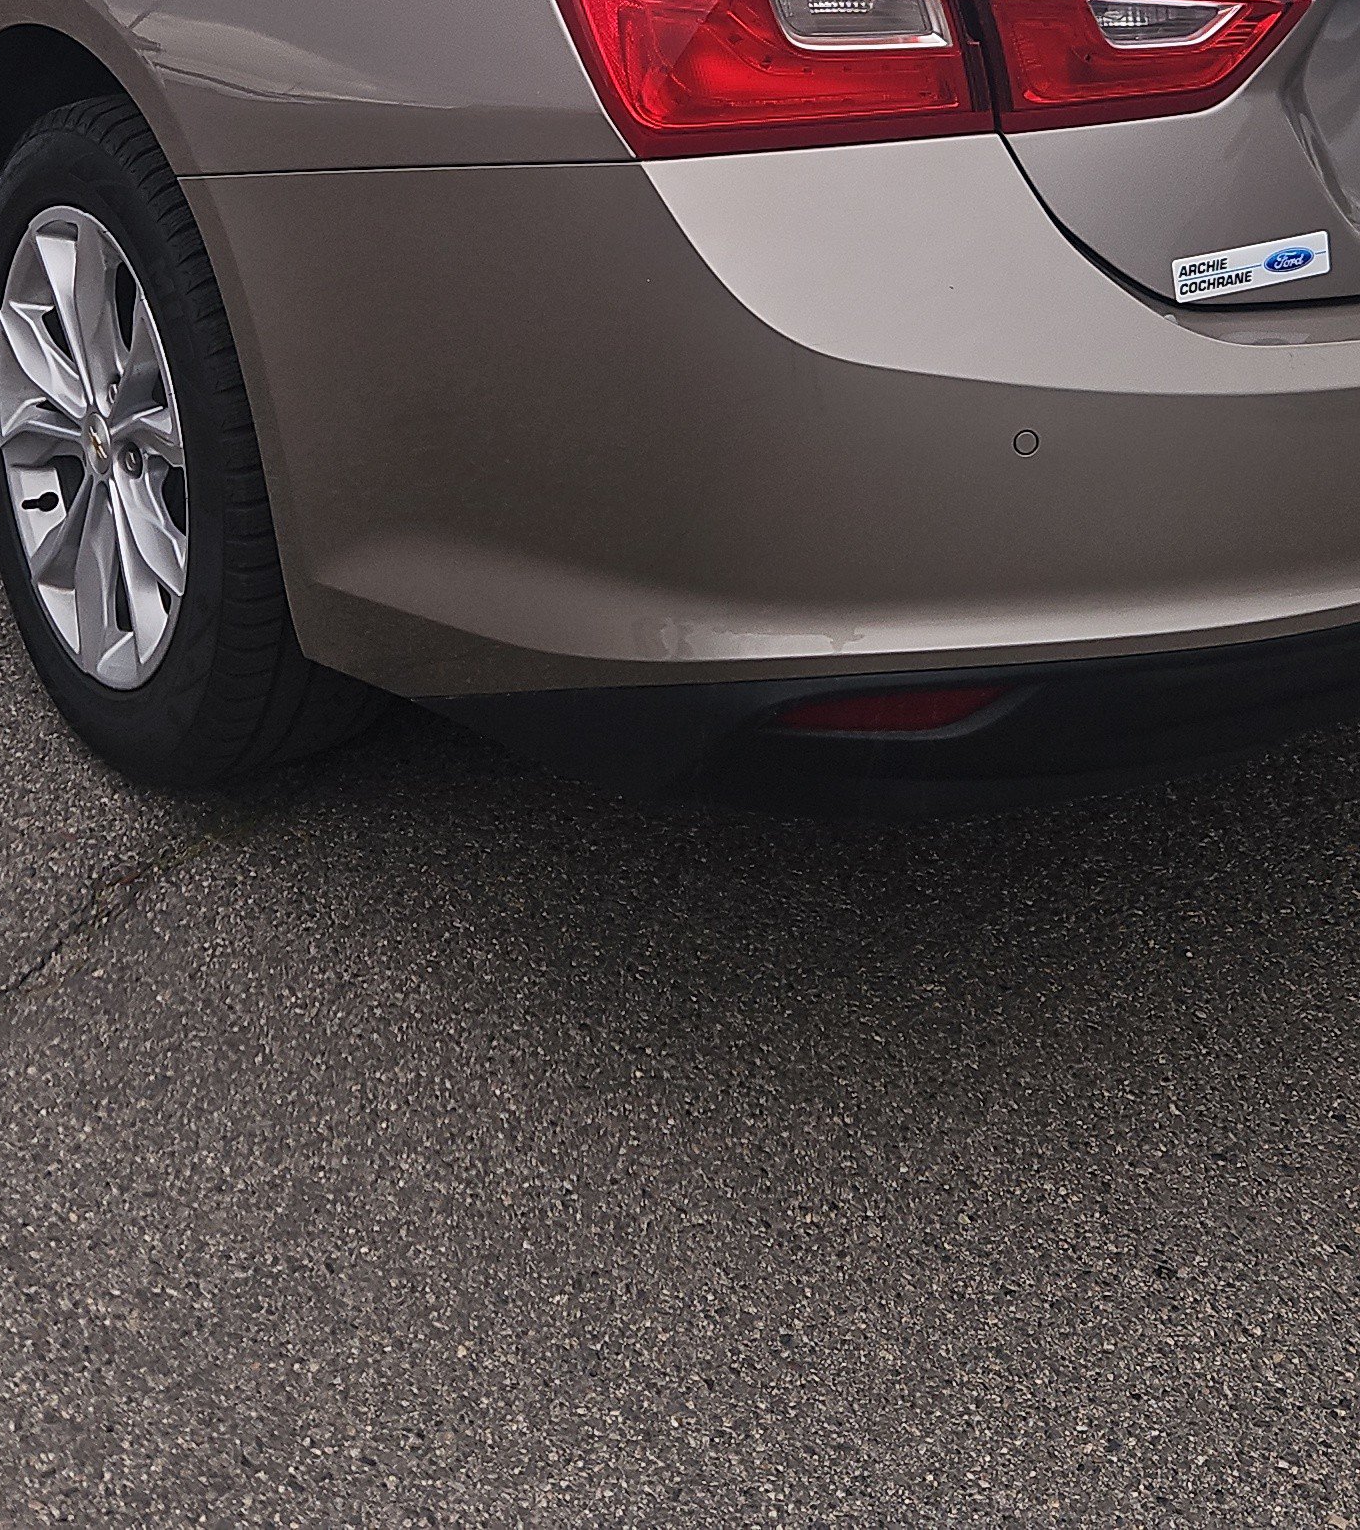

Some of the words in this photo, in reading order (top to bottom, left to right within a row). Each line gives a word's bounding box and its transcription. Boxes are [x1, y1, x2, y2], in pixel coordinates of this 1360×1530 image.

[1179, 257, 1228, 278] ARCHIE
[1273, 252, 1304, 269] Ford
[1179, 270, 1253, 295] COCHRANE
